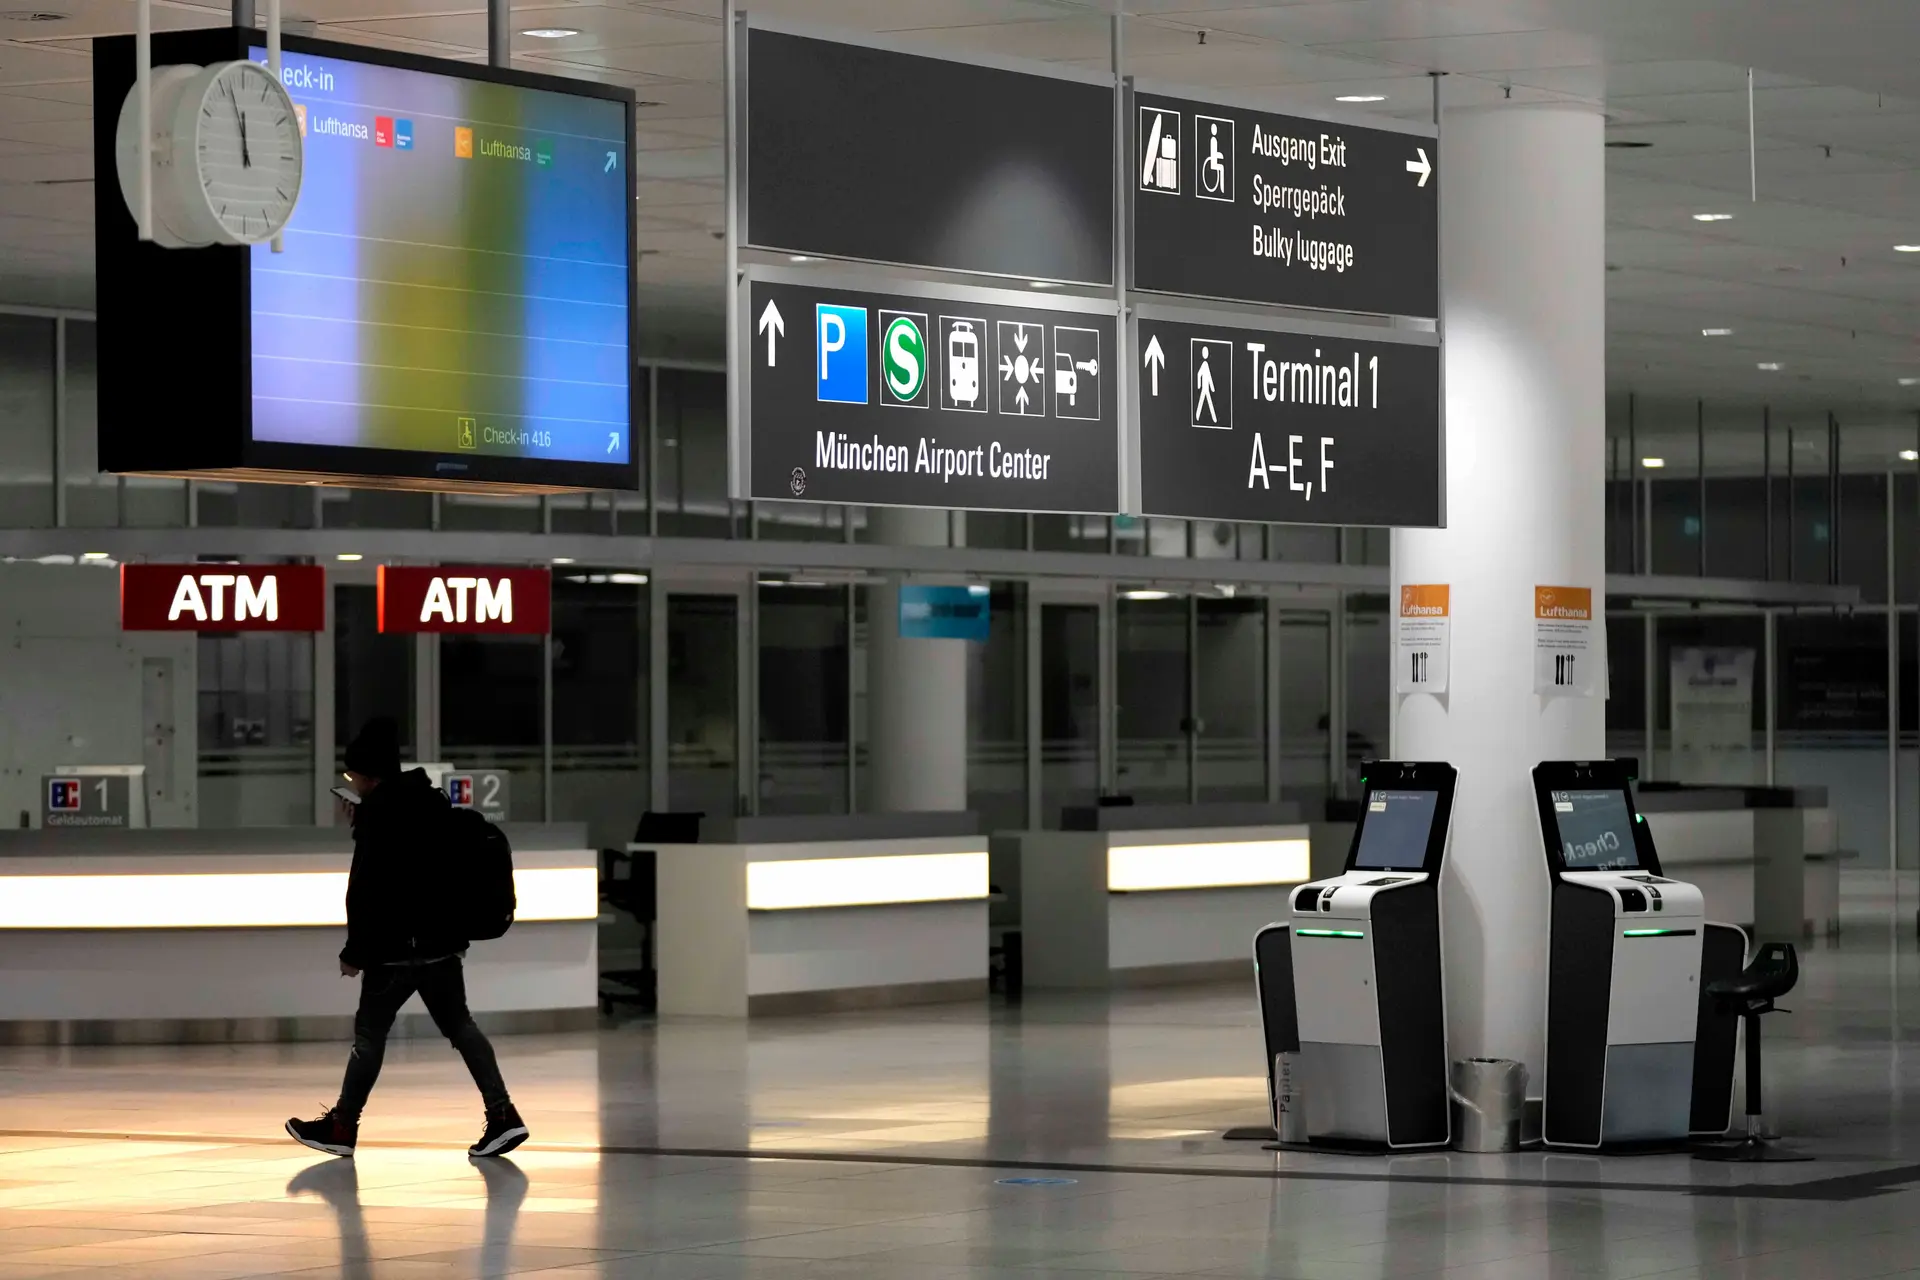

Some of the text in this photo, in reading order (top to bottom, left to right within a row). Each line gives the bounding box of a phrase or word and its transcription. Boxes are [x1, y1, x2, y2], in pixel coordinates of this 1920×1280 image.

[313, 115, 368, 139] Lufthansa
[480, 138, 532, 162] Lufthansa
[1252, 123, 1347, 170] Ausgang Exit
[1252, 173, 1345, 220] Sperrgepäck
[1253, 224, 1354, 273] Bulky luggage
[820, 313, 920, 395] P S
[1246, 342, 1379, 409] Terminal 1
[483, 426, 552, 448] Check-in 416
[815, 430, 1051, 484] München Airport Center
[1320, 436, 1335, 493] F
[167, 574, 279, 622] ATM
[419, 576, 513, 624] ATM
[1402, 604, 1443, 616] Lufthansa
[1540, 605, 1588, 618] Lufthansa
[95, 778, 108, 812] 1
[482, 774, 501, 808] 2
[47, 814, 124, 826] Geldautomat
